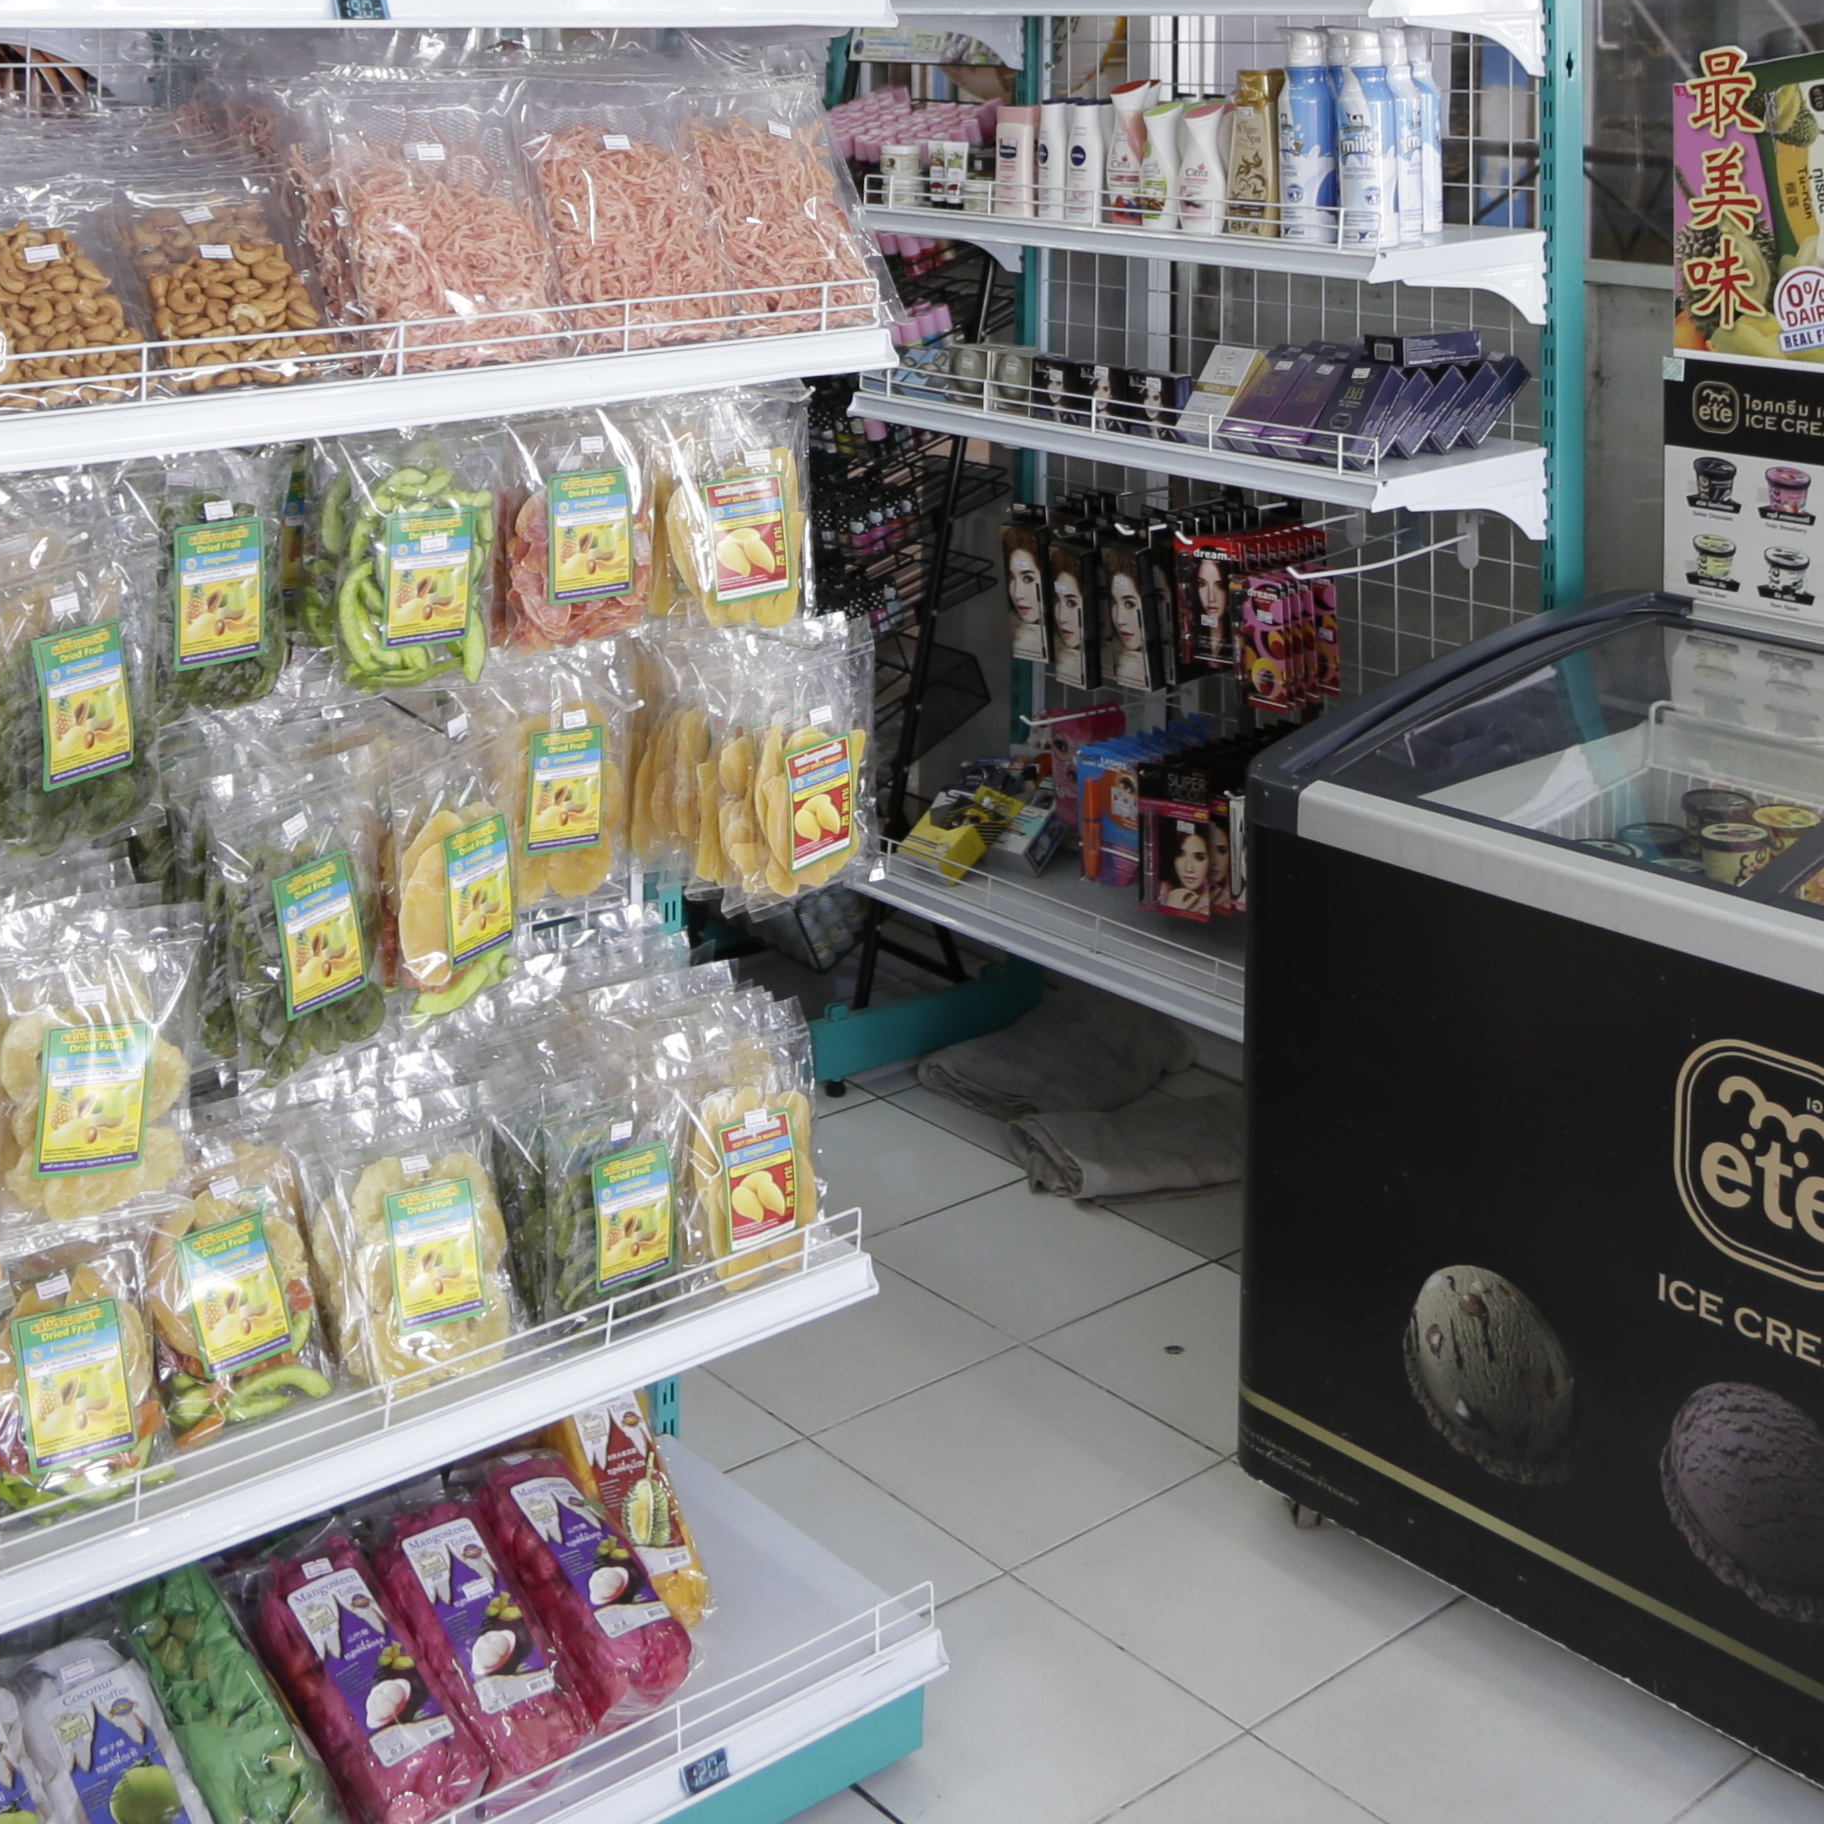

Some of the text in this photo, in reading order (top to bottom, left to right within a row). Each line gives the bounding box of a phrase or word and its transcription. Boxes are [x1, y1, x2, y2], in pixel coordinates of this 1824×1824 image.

[1686, 48, 1766, 329] 最美味
[1783, 328, 1814, 349] REAL
[1744, 393, 1810, 418] ไอศกรีม
[1744, 413, 1778, 432] ICE
[1166, 773, 1207, 792] SUPER
[1656, 1271, 1724, 1326] ICE
[408, 1521, 472, 1550] Mangosteen
[293, 1571, 358, 1607] Mangosteen
[62, 1677, 114, 1707] Coconut
[97, 1686, 131, 1705] Toffee
